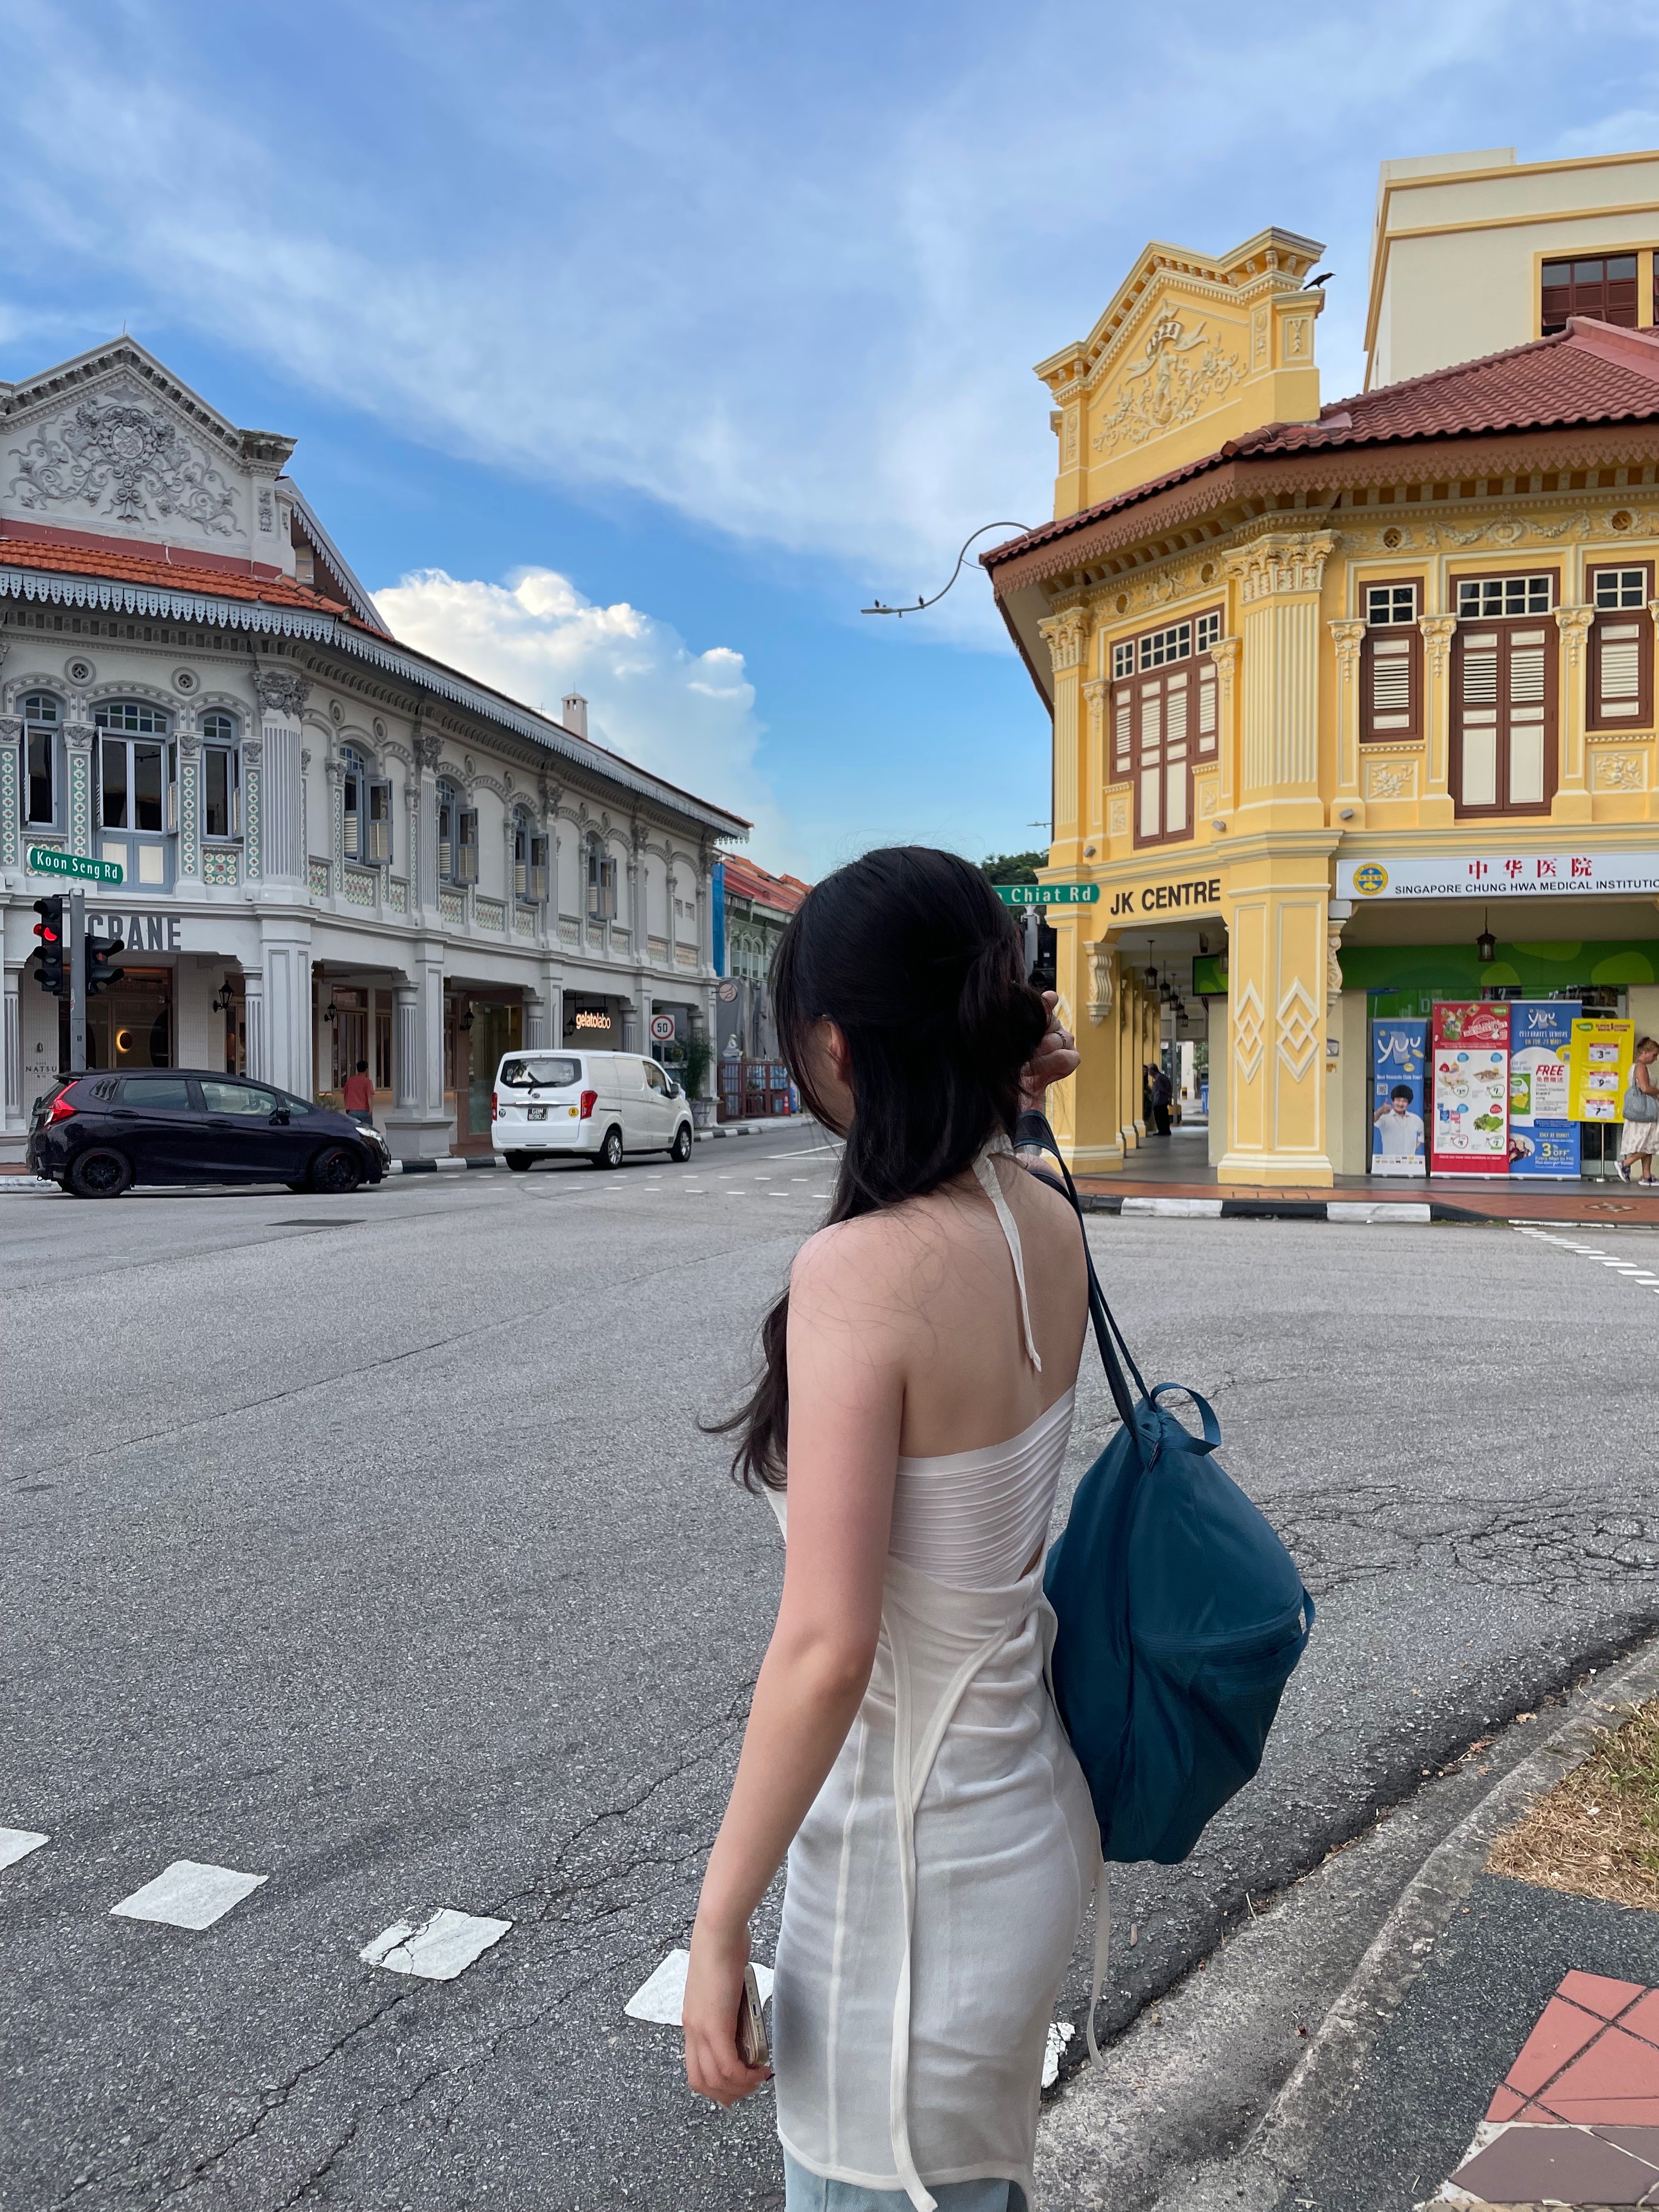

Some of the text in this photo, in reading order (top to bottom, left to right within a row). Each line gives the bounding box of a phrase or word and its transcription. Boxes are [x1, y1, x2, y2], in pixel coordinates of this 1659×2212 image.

[37, 851, 117, 879] Koon Seng Rd
[1469, 857, 1592, 879] 中华医院
[1011, 888, 1060, 902] Chiat
[1070, 887, 1091, 901] Rd
[1110, 879, 1221, 916] JK CENTRE
[1395, 884, 1462, 895] SINGAPORE
[1465, 882, 1506, 893] CHUNG
[1510, 882, 1536, 892] HWA
[1540, 881, 1593, 891] MEDICAL
[88, 915, 180, 950] CRANE
[576, 1011, 611, 1030] gelatolabo
[657, 1023, 668, 1033] 50
[1528, 1012, 1555, 1029] yuu
[1377, 1036, 1421, 1064] yuu
[1536, 1065, 1565, 1075] FREE
